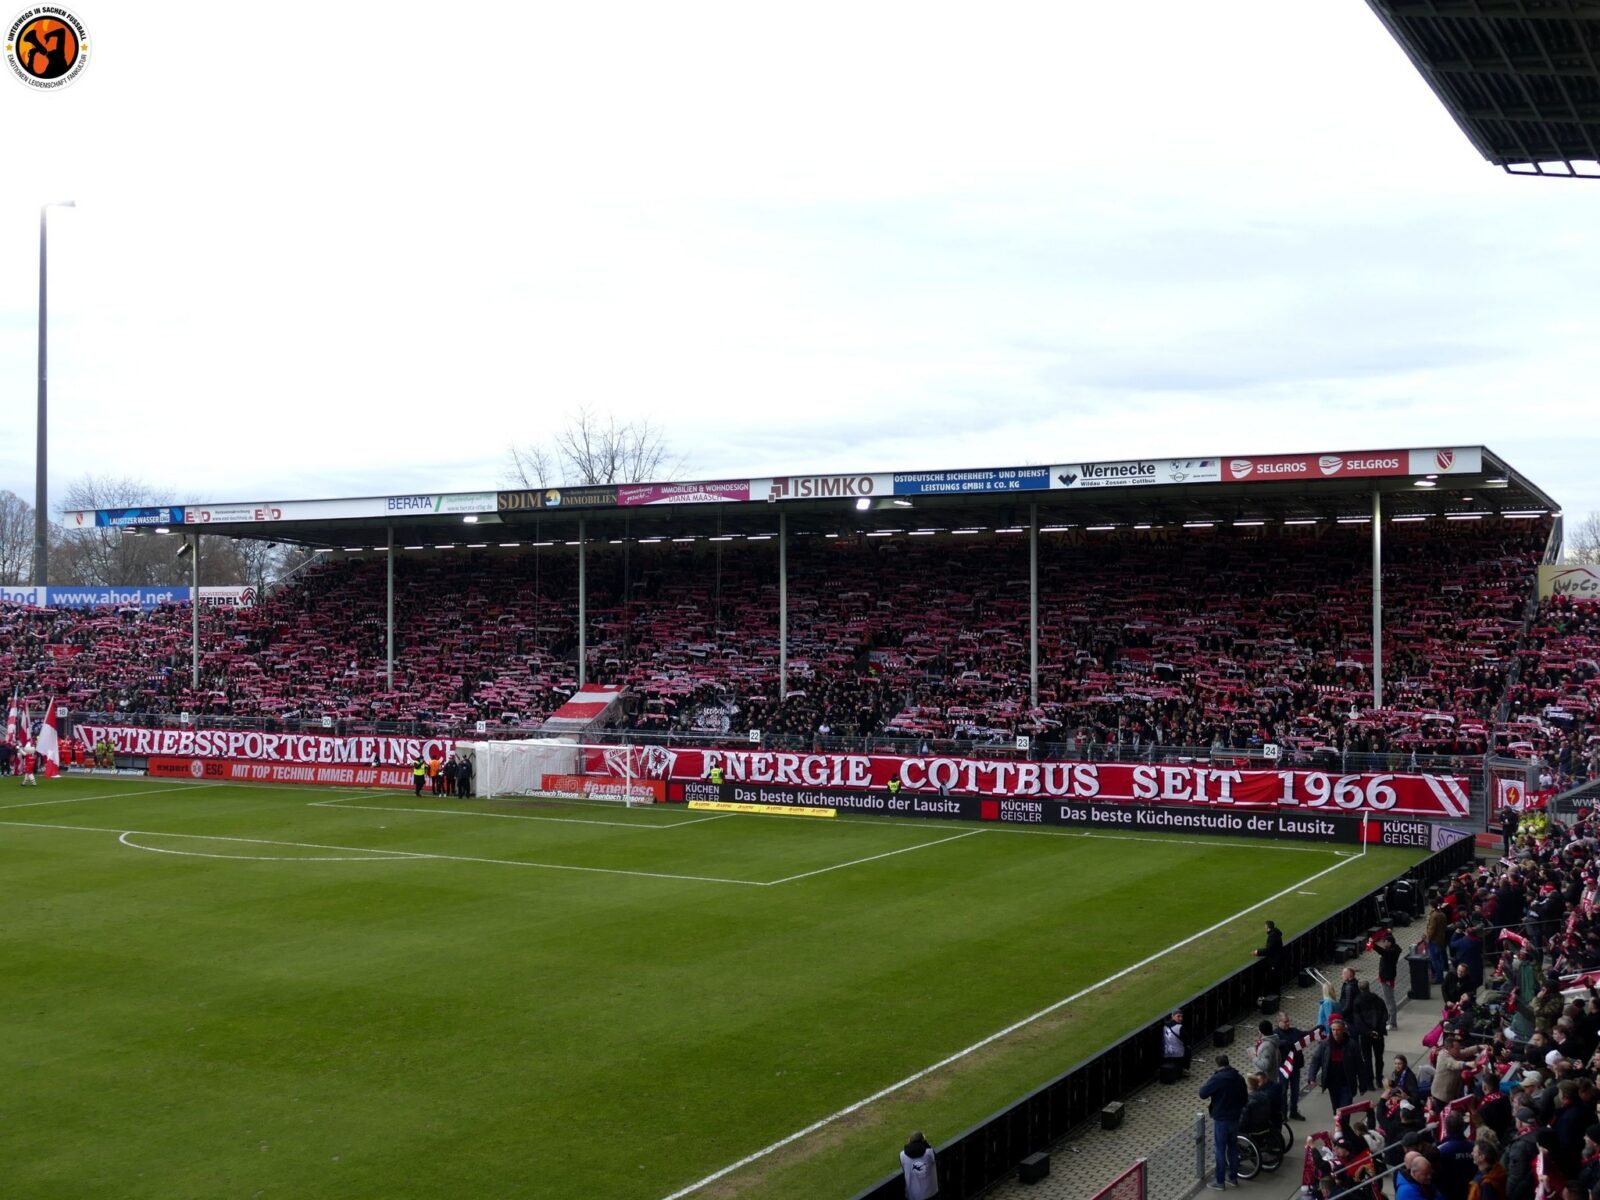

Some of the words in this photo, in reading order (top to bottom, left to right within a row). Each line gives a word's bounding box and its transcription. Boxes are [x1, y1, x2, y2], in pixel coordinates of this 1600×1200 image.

[1080, 462, 1156, 478] Wernecke
[1257, 462, 1307, 474] SELGROS
[1346, 459, 1399, 470] SELGROS
[894, 473, 944, 483] OSTDEUTSCHE
[946, 472, 997, 481] SICHERHEITS-
[999, 471, 1015, 479] UND
[1018, 470, 1048, 478] DIENST-
[661, 485, 698, 494] IMMOBILIEN
[706, 483, 749, 492] WOHNDESIGN
[794, 477, 874, 497] ISIMKO
[921, 483, 960, 492] LEISTUNGS
[962, 482, 984, 490] GMBH
[388, 497, 432, 510] BERATA
[498, 493, 542, 510] SDIM
[563, 494, 617, 505] IMMOBILIEN
[669, 494, 691, 503] DIANA
[109, 517, 138, 526] LAUSITZER
[138, 516, 160, 524] WASSER
[53, 590, 173, 604] www.ahod.net
[751, 732, 759, 740] 22
[1018, 738, 1027, 747] 23
[1266, 746, 1276, 756] 24
[206, 763, 223, 775] ESC
[231, 764, 249, 778] MIT
[252, 765, 270, 779] TOP
[273, 766, 316, 781] TECHNIK
[317, 768, 353, 783] IMMER
[355, 770, 377, 784] AUF
[700, 750, 873, 787] ENERGIE
[899, 758, 1100, 797] COTTBUS
[1132, 765, 1242, 803] SEIT
[1277, 771, 1397, 810] 1966
[685, 783, 720, 794] KÜCHEN
[685, 793, 720, 803] GEISLER
[734, 788, 757, 801] Das
[759, 789, 794, 804] beste
[797, 792, 884, 809] Küchenstudio
[887, 797, 911, 811] der
[914, 798, 960, 814] Lausitz
[1000, 800, 1042, 812] KÜCHEN
[1000, 811, 1042, 823] GEISLER
[1060, 806, 1087, 820] Das
[1091, 807, 1132, 823] beste
[1136, 810, 1242, 829] Küchenstudio
[1247, 815, 1274, 831] der
[1279, 817, 1335, 835] Lausitz
[1383, 820, 1429, 834] KÜCHEN
[1383, 833, 1429, 847] GEISLER
